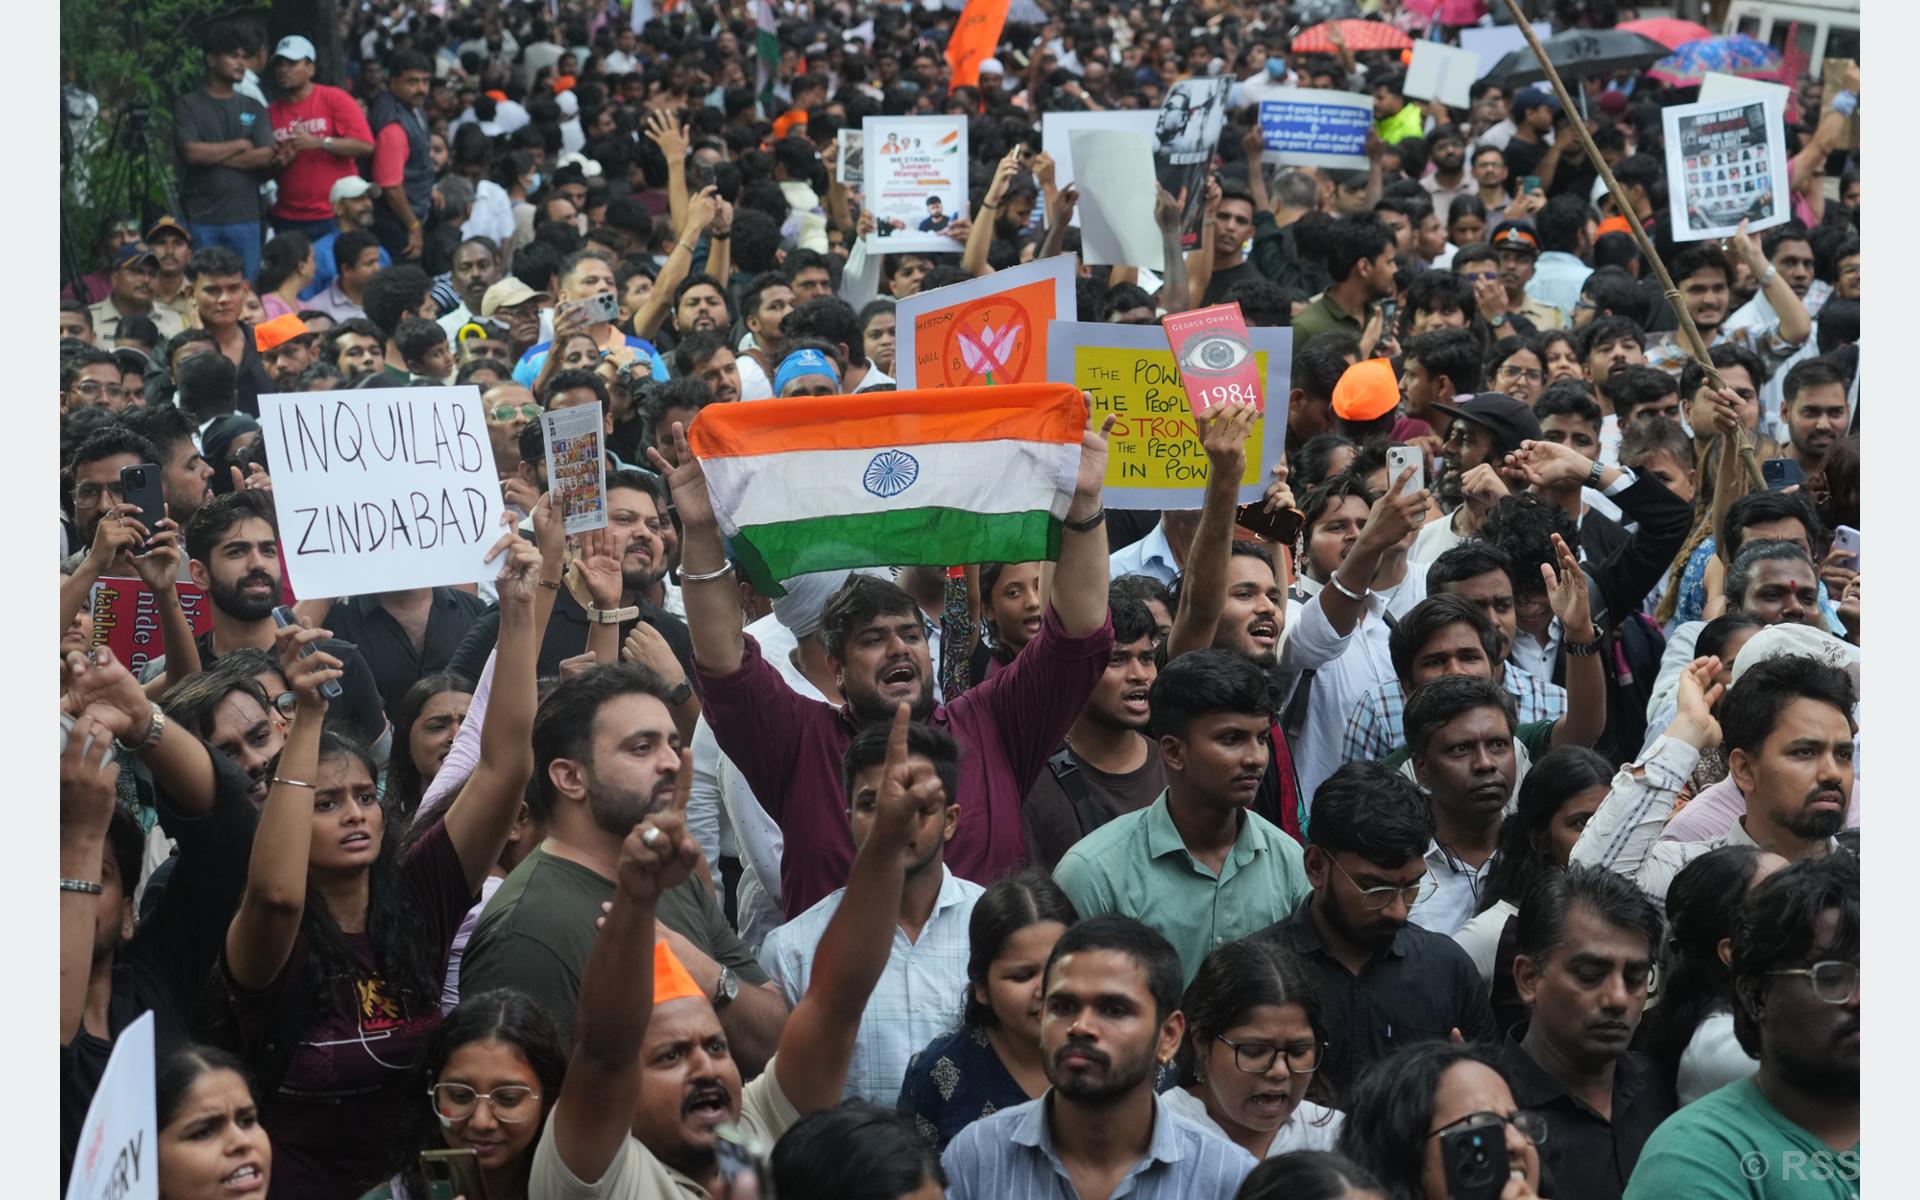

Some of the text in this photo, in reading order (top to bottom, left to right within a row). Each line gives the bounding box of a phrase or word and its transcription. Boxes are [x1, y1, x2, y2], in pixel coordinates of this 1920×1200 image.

[916, 312, 955, 331] HISTORY
[982, 311, 992, 322] J
[1171, 314, 1241, 332] GEORGE ORWELL
[918, 352, 940, 366] WILL
[952, 358, 961, 371] B
[1087, 367, 1121, 381] THE
[1145, 388, 1190, 413] PEOPL
[1198, 383, 1257, 409] 1984
[1110, 413, 1199, 438] STRON
[278, 401, 483, 473] INQUILAB
[1116, 437, 1208, 458] THE PEOPL
[1122, 458, 1208, 481] IN POW
[294, 487, 488, 555] ZINDABAD
[93, 587, 119, 650] failu
